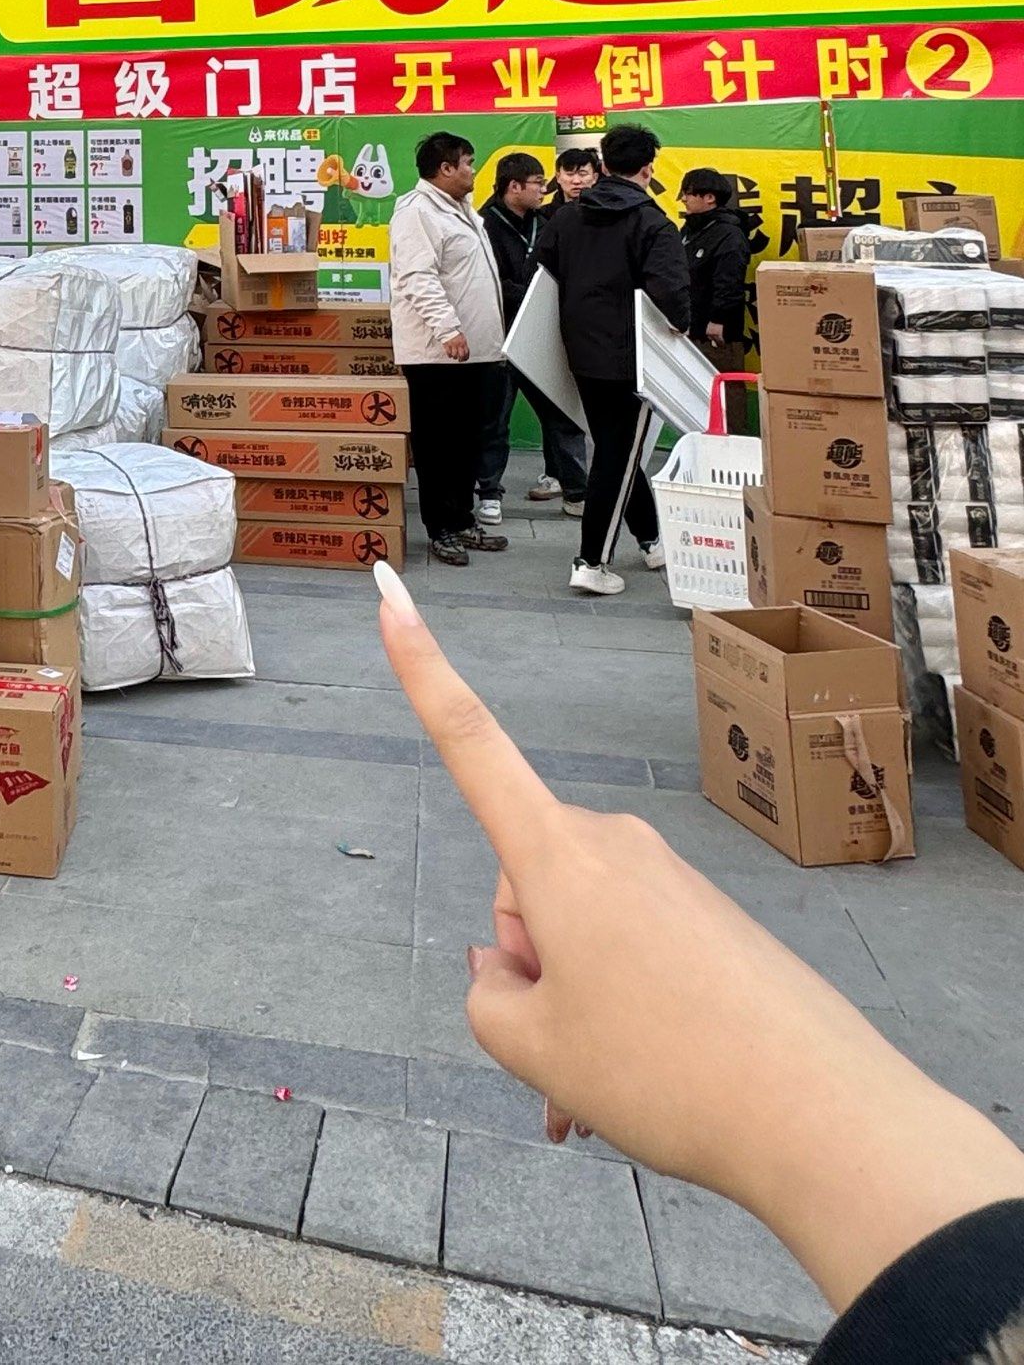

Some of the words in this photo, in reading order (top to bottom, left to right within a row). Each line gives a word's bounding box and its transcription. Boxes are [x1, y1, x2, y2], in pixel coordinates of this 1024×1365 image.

[264, 129, 302, 141] 来优品
[281, 395, 352, 409] 香辣风干鸭脖
